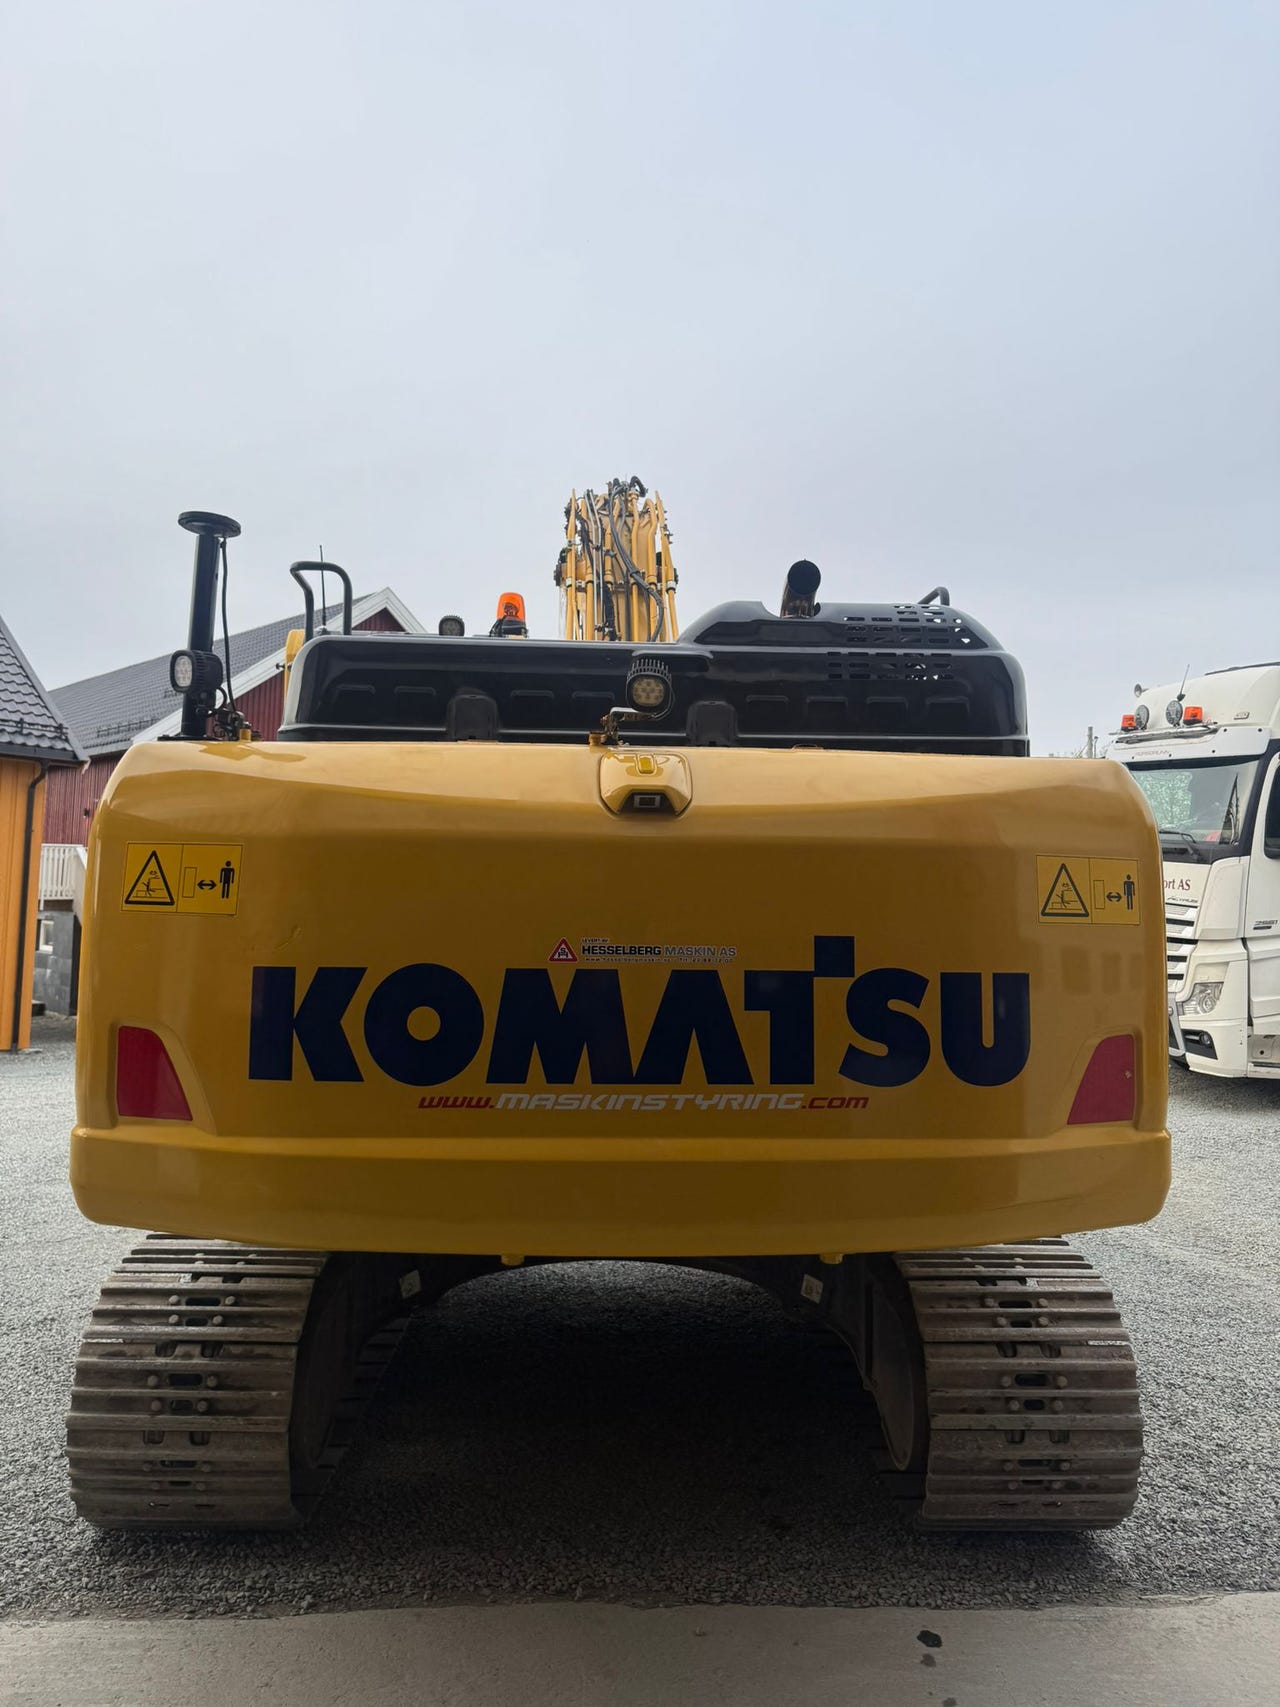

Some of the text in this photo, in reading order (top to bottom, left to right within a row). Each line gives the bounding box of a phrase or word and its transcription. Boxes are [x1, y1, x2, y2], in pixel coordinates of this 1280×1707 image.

[1177, 879, 1191, 891] AS
[582, 945, 737, 957] HESSELBERG MASKIN AS
[248, 935, 1030, 1087] KOMATSU
